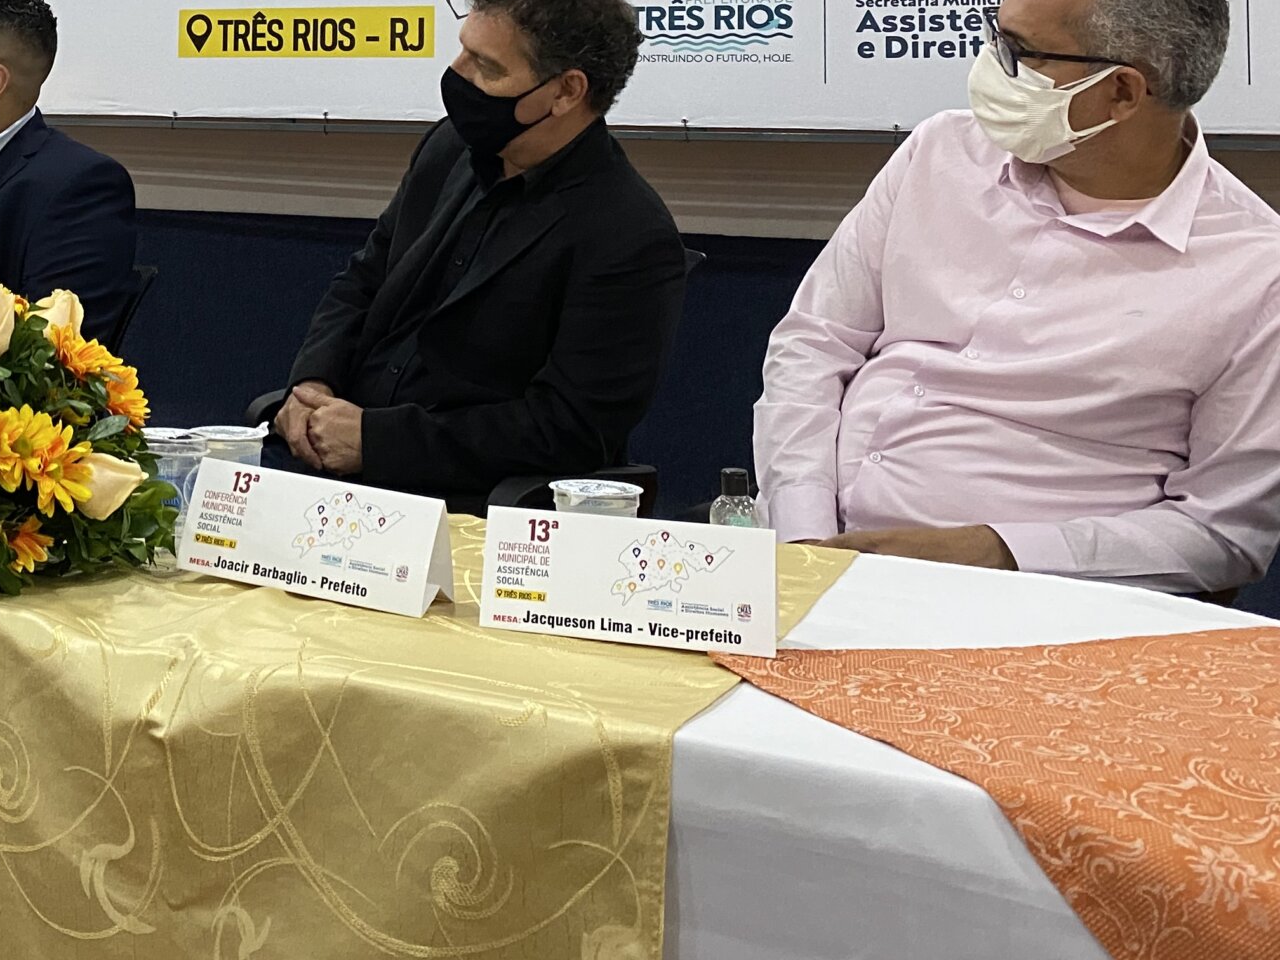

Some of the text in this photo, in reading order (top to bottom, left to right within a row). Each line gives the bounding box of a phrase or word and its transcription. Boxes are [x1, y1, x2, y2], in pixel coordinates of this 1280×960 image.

[714, 3, 794, 31] RIOS
[856, 7, 984, 33] Assistê
[217, 11, 284, 53] TRÊS
[292, 19, 356, 52] RIOS
[389, 17, 426, 52] RJ
[857, 33, 985, 59] e Direit
[636, 53, 794, 64] ONSTRUINDO O FUTURO, HOJE.
[233, 471, 261, 494] 13ª
[204, 490, 248, 506] CONFERÊNCIA
[201, 500, 246, 517] MUNICIPAL DE
[197, 521, 221, 533] SOCIAL
[199, 512, 243, 527] ASSISTÊNCIA
[528, 518, 559, 542] 13ª
[498, 541, 550, 555] CONFERÊNCIA
[497, 553, 550, 566] MUNICIPAL DE
[189, 556, 213, 568] MESA:
[214, 555, 250, 574] Joacir
[252, 565, 308, 585] Barbaglio
[319, 576, 368, 597] Prefeito
[496, 565, 550, 578] ASSISTÊNCIA
[496, 575, 525, 586] SOCIAL
[503, 590, 518, 600] TRÊS
[537, 593, 546, 602] RJ
[493, 614, 521, 624] MESA:
[522, 610, 596, 630] Jacqueson
[600, 617, 633, 634] Lima
[648, 622, 742, 645] Vice-prefeito
